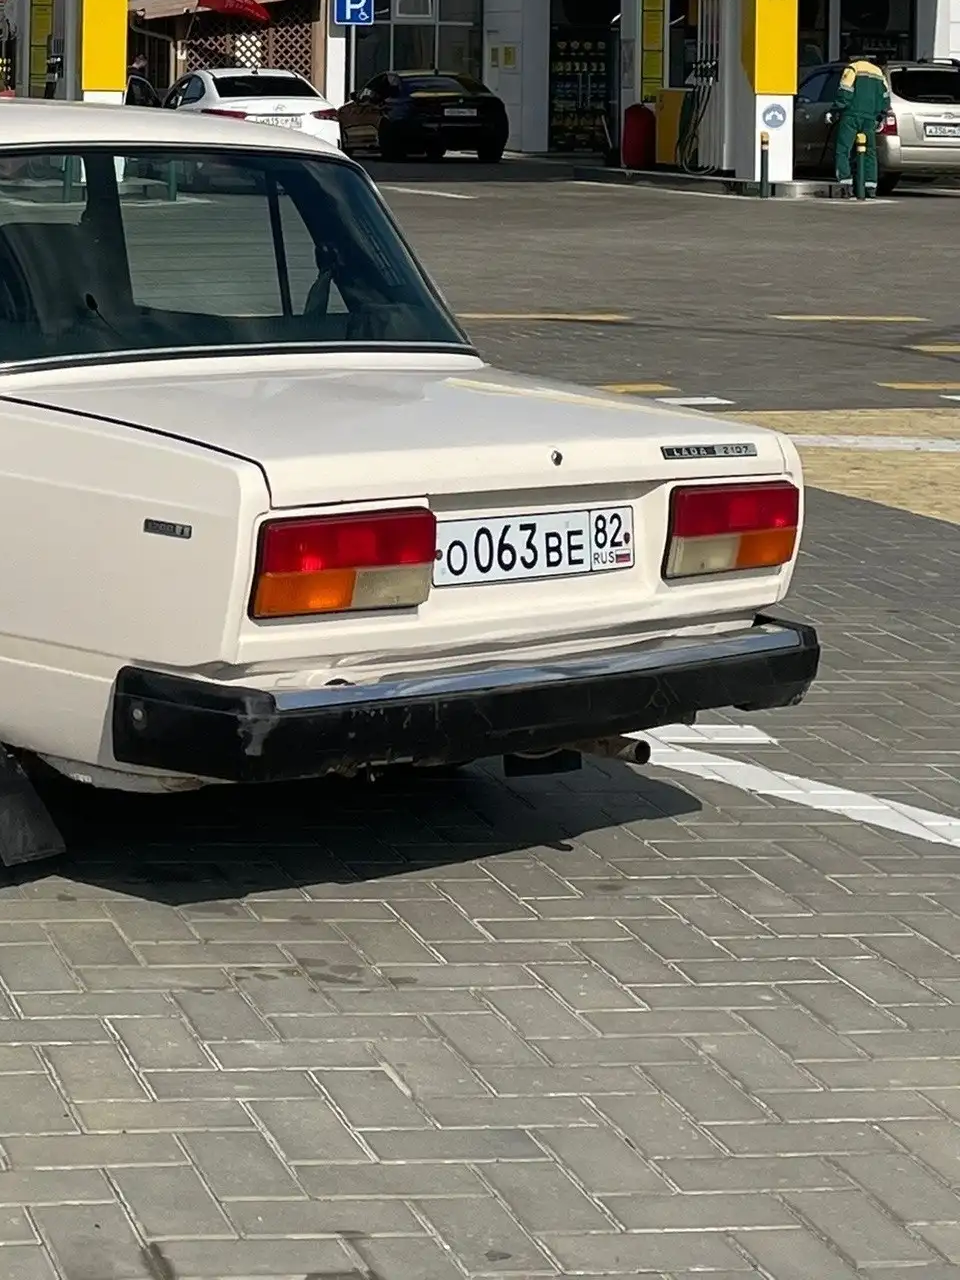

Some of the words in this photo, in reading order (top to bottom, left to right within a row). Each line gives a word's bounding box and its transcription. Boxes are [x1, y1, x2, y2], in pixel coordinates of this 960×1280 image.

[672, 446, 708, 457] LADA
[722, 445, 749, 455] 2107
[594, 512, 624, 549] 82
[592, 550, 616, 565] RUS
